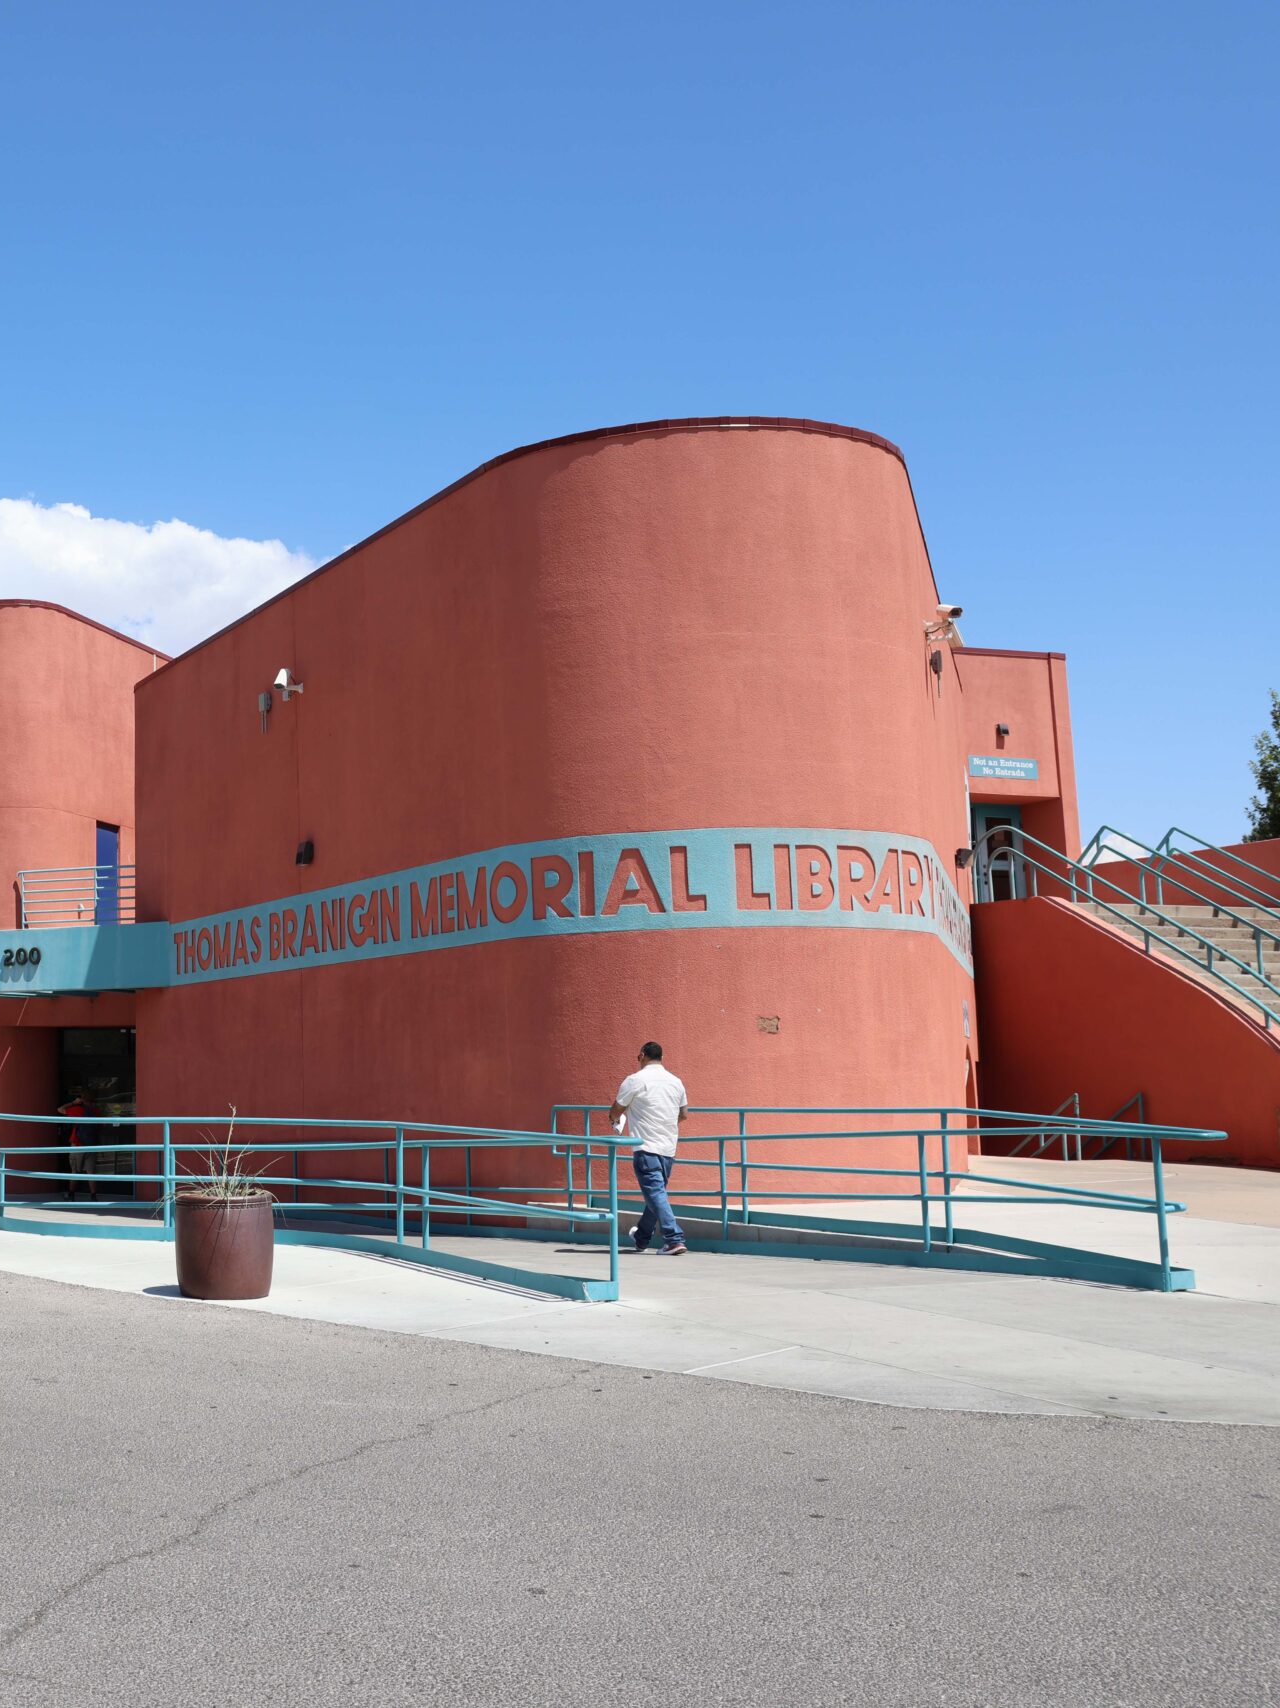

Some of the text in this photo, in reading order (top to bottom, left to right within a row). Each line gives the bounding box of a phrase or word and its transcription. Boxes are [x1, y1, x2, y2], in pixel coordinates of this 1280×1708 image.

[973, 758, 986, 766] Not
[1000, 760, 1034, 768] Entrance
[983, 767, 1026, 777] No Entrada
[174, 916, 262, 975] THOMAS
[269, 886, 401, 961] BRANIGAN
[410, 845, 707, 939] MEMORIAL
[734, 843, 936, 919] LIBRARY
[3, 947, 41, 966] 200
